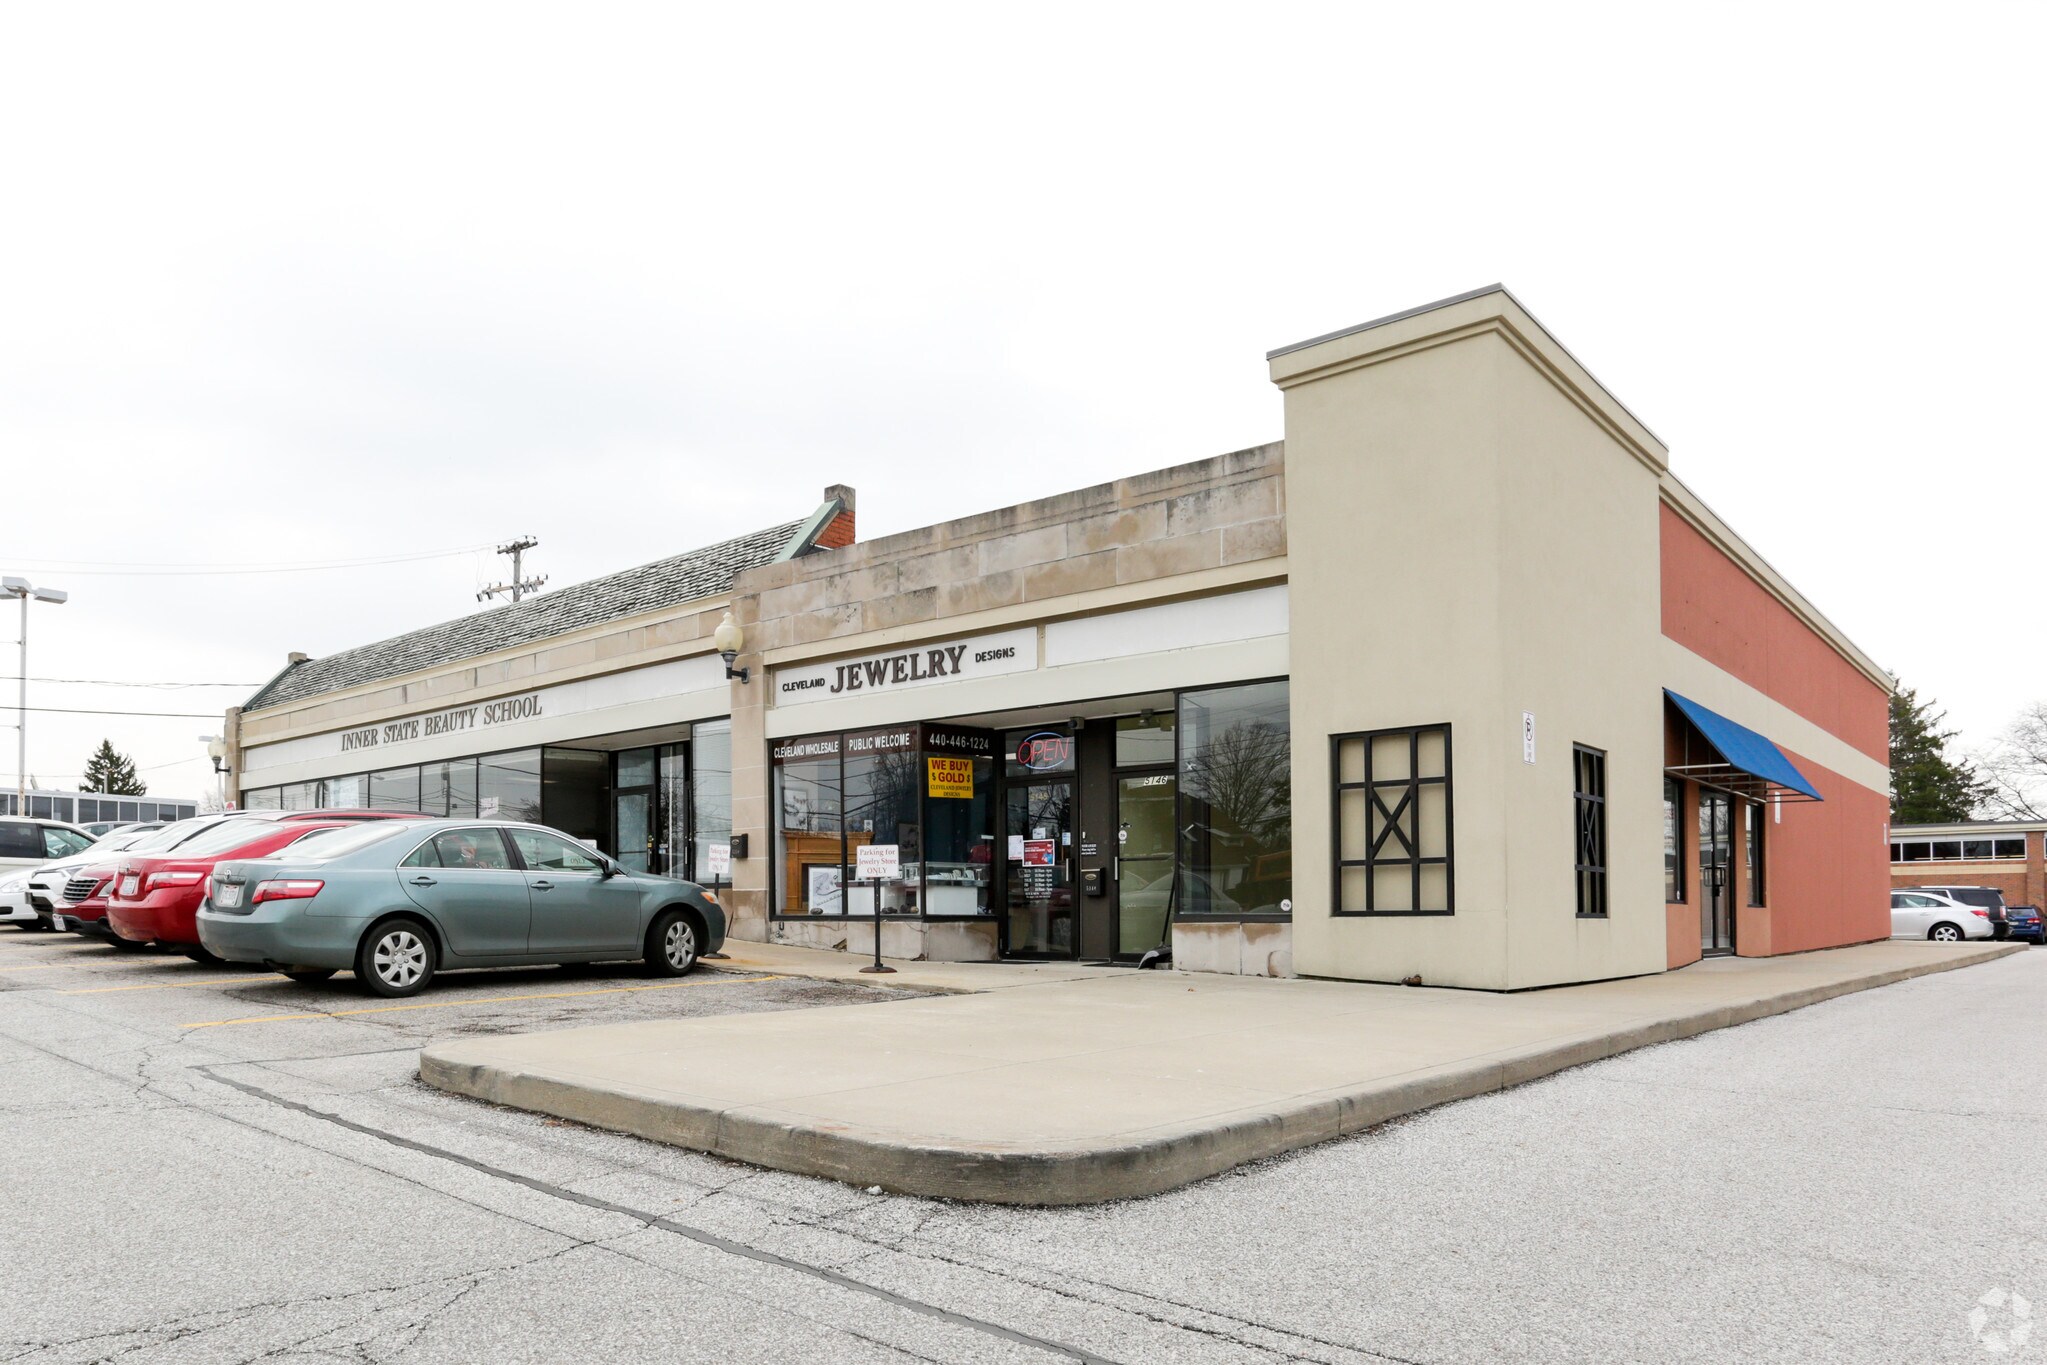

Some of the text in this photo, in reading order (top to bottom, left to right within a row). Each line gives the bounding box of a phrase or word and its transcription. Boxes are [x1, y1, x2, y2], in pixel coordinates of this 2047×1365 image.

[782, 644, 1015, 694] CLEVELAND JEWELRY DESIGNS
[341, 695, 543, 751] INNER STATE BEAUTY SCHOOL
[774, 741, 839, 759] CLEVELAND WHOLESALE
[848, 733, 910, 752] PUBLIC WELCOME
[929, 733, 989, 750] 440-446-1224
[1018, 737, 1070, 764] OPEN
[932, 760, 969, 771] WE BUY
[938, 772, 965, 783] GOLD
[1144, 775, 1168, 785] 5146
[860, 849, 884, 857] Parking
[859, 858, 880, 866] Jewelry
